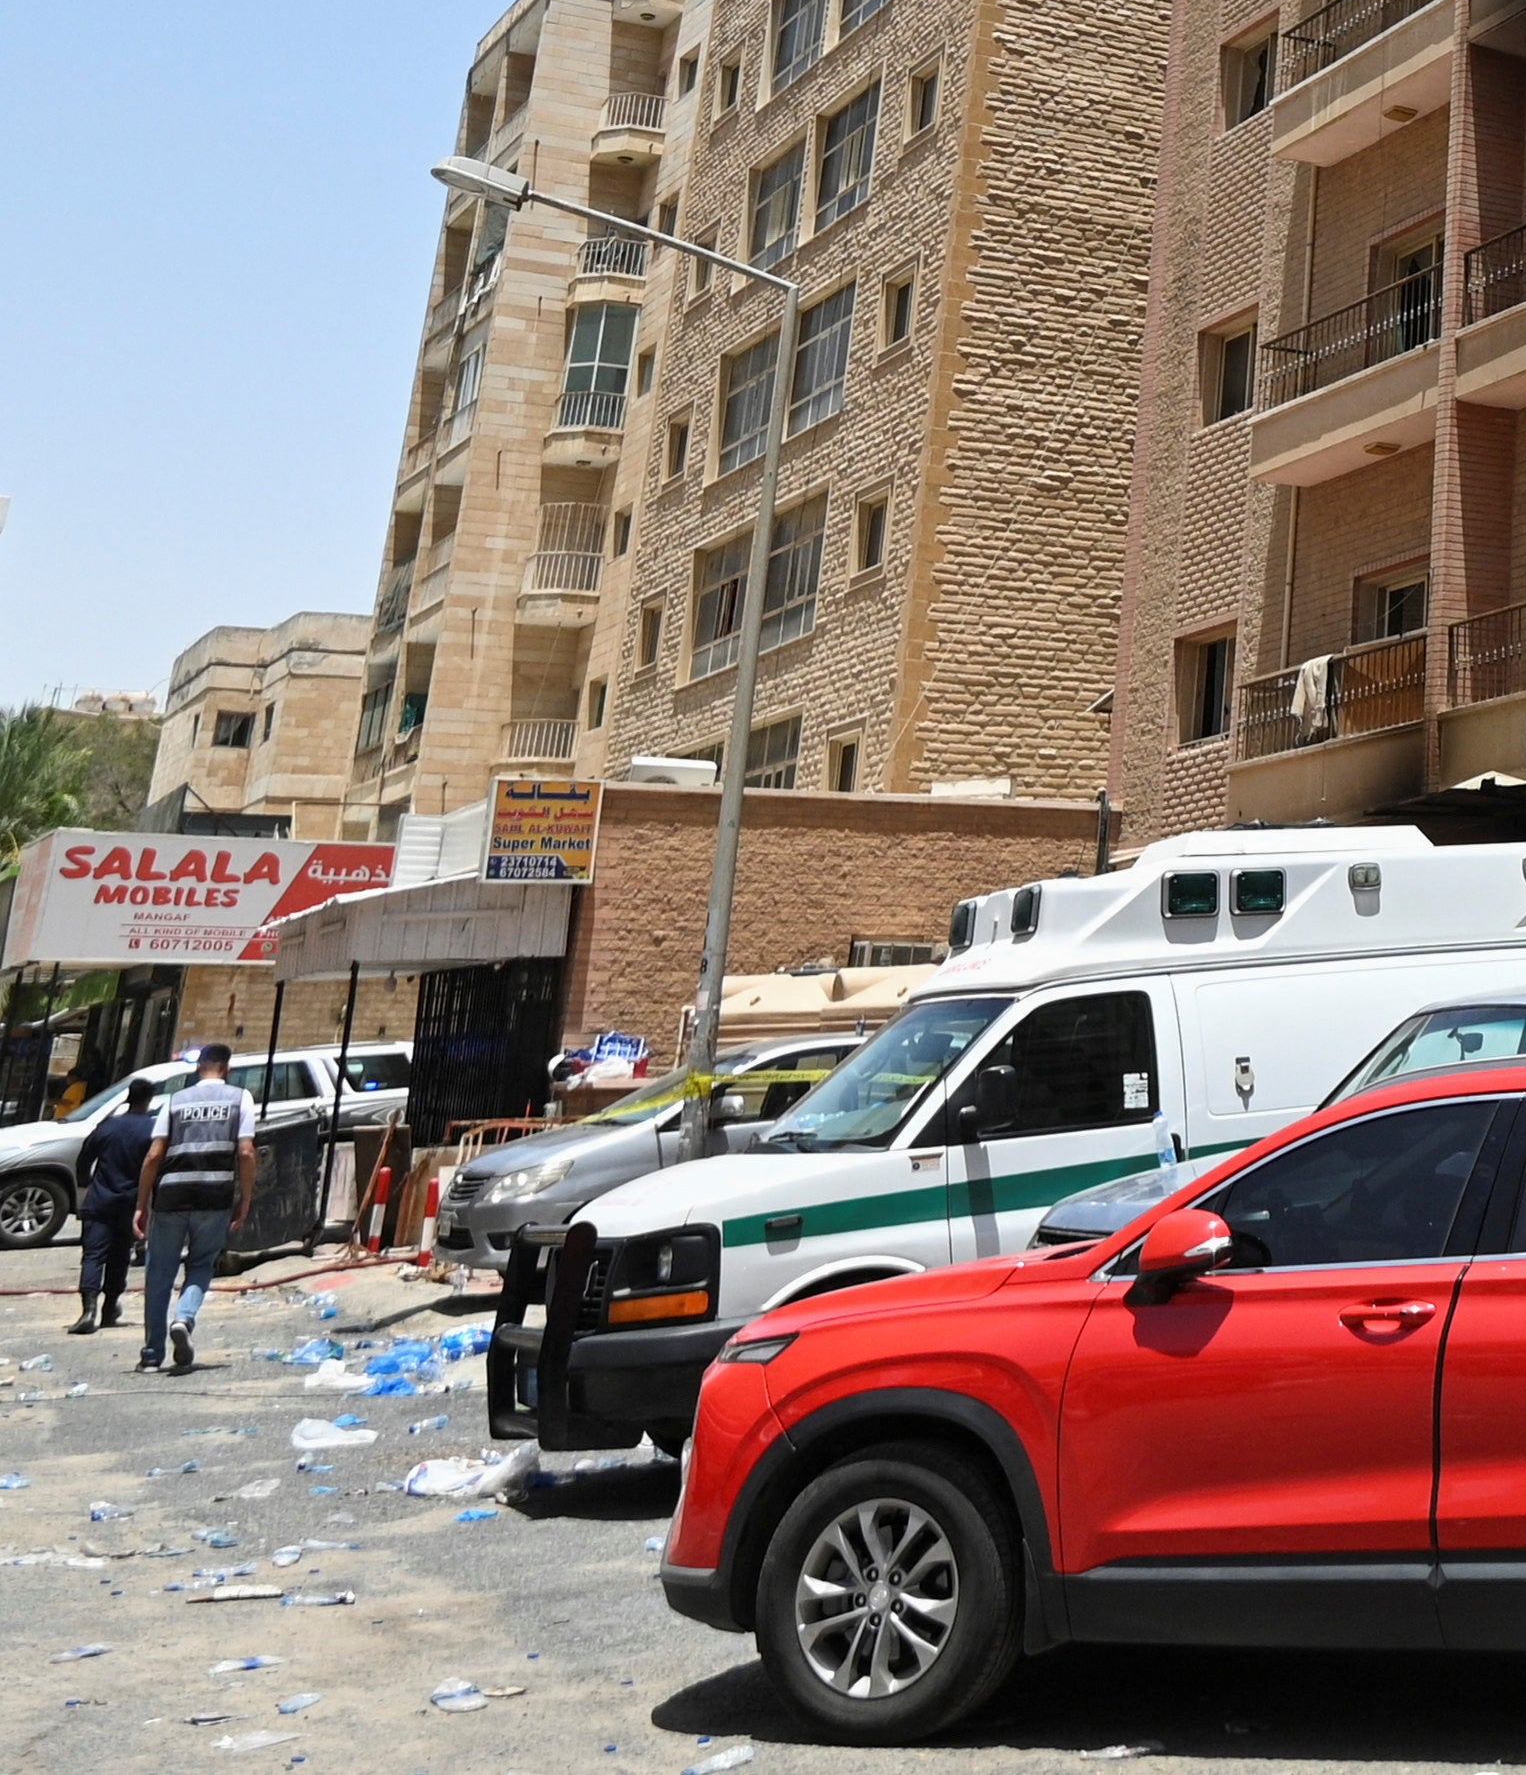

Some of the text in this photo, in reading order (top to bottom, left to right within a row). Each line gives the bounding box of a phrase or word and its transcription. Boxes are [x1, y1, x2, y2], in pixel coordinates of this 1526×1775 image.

[493, 836, 591, 852] Super Market
[59, 845, 281, 886] SALALA
[501, 856, 557, 866] 23710714
[500, 867, 556, 878] 67072584
[93, 884, 241, 908] MOBILES
[133, 912, 191, 922] MANGAF
[129, 927, 149, 935] ALL
[154, 928, 182, 936] KIND
[203, 929, 247, 937] MOBILE
[149, 938, 234, 952] 60712005
[183, 1105, 229, 1120] POLICE
